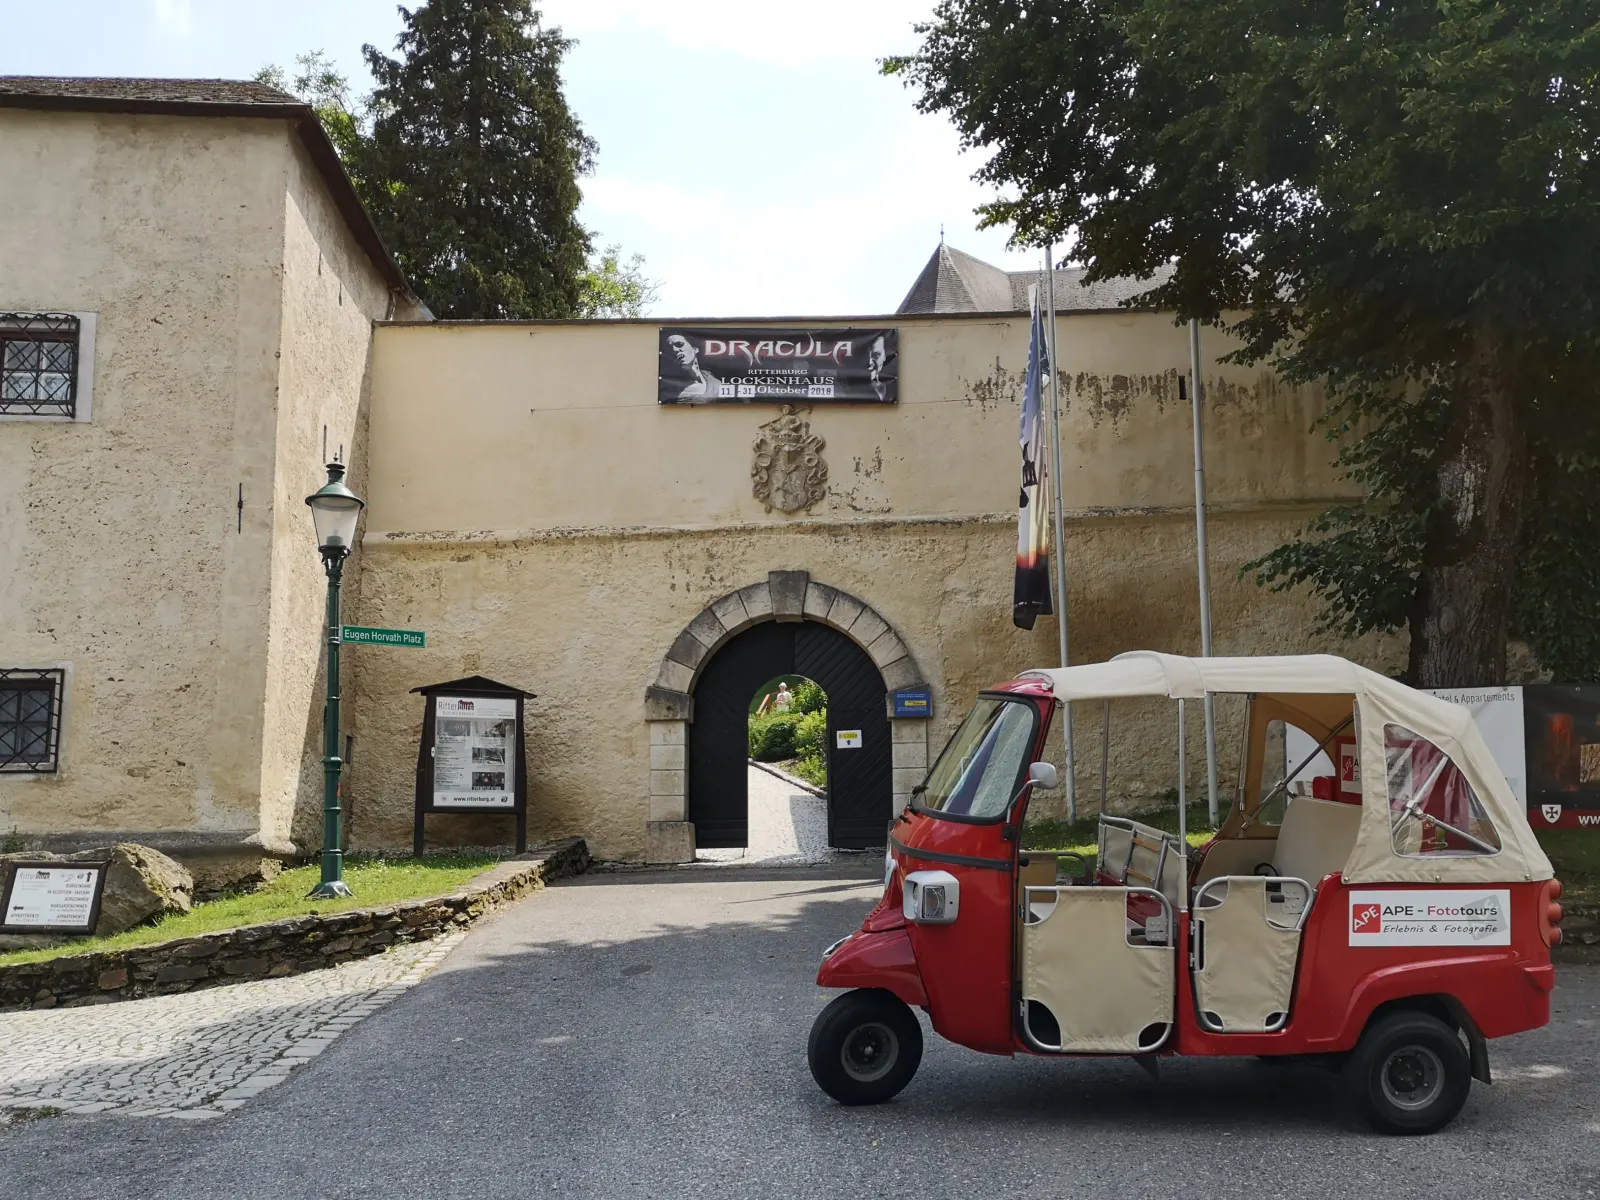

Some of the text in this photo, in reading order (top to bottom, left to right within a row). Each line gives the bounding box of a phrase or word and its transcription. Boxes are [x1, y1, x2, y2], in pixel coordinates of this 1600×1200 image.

[704, 332, 853, 366] DRACULA
[721, 376, 835, 385] LOCKENHAUS
[757, 386, 808, 395] Oktober
[344, 629, 422, 644] Eugen Horvath Platz
[1461, 693, 1515, 705] Appartements
[1382, 905, 1414, 916] APE
[1427, 905, 1498, 917] Fototours
[1353, 906, 1379, 931] APE
[1383, 924, 1498, 935] Erlebnis & Fotografie
